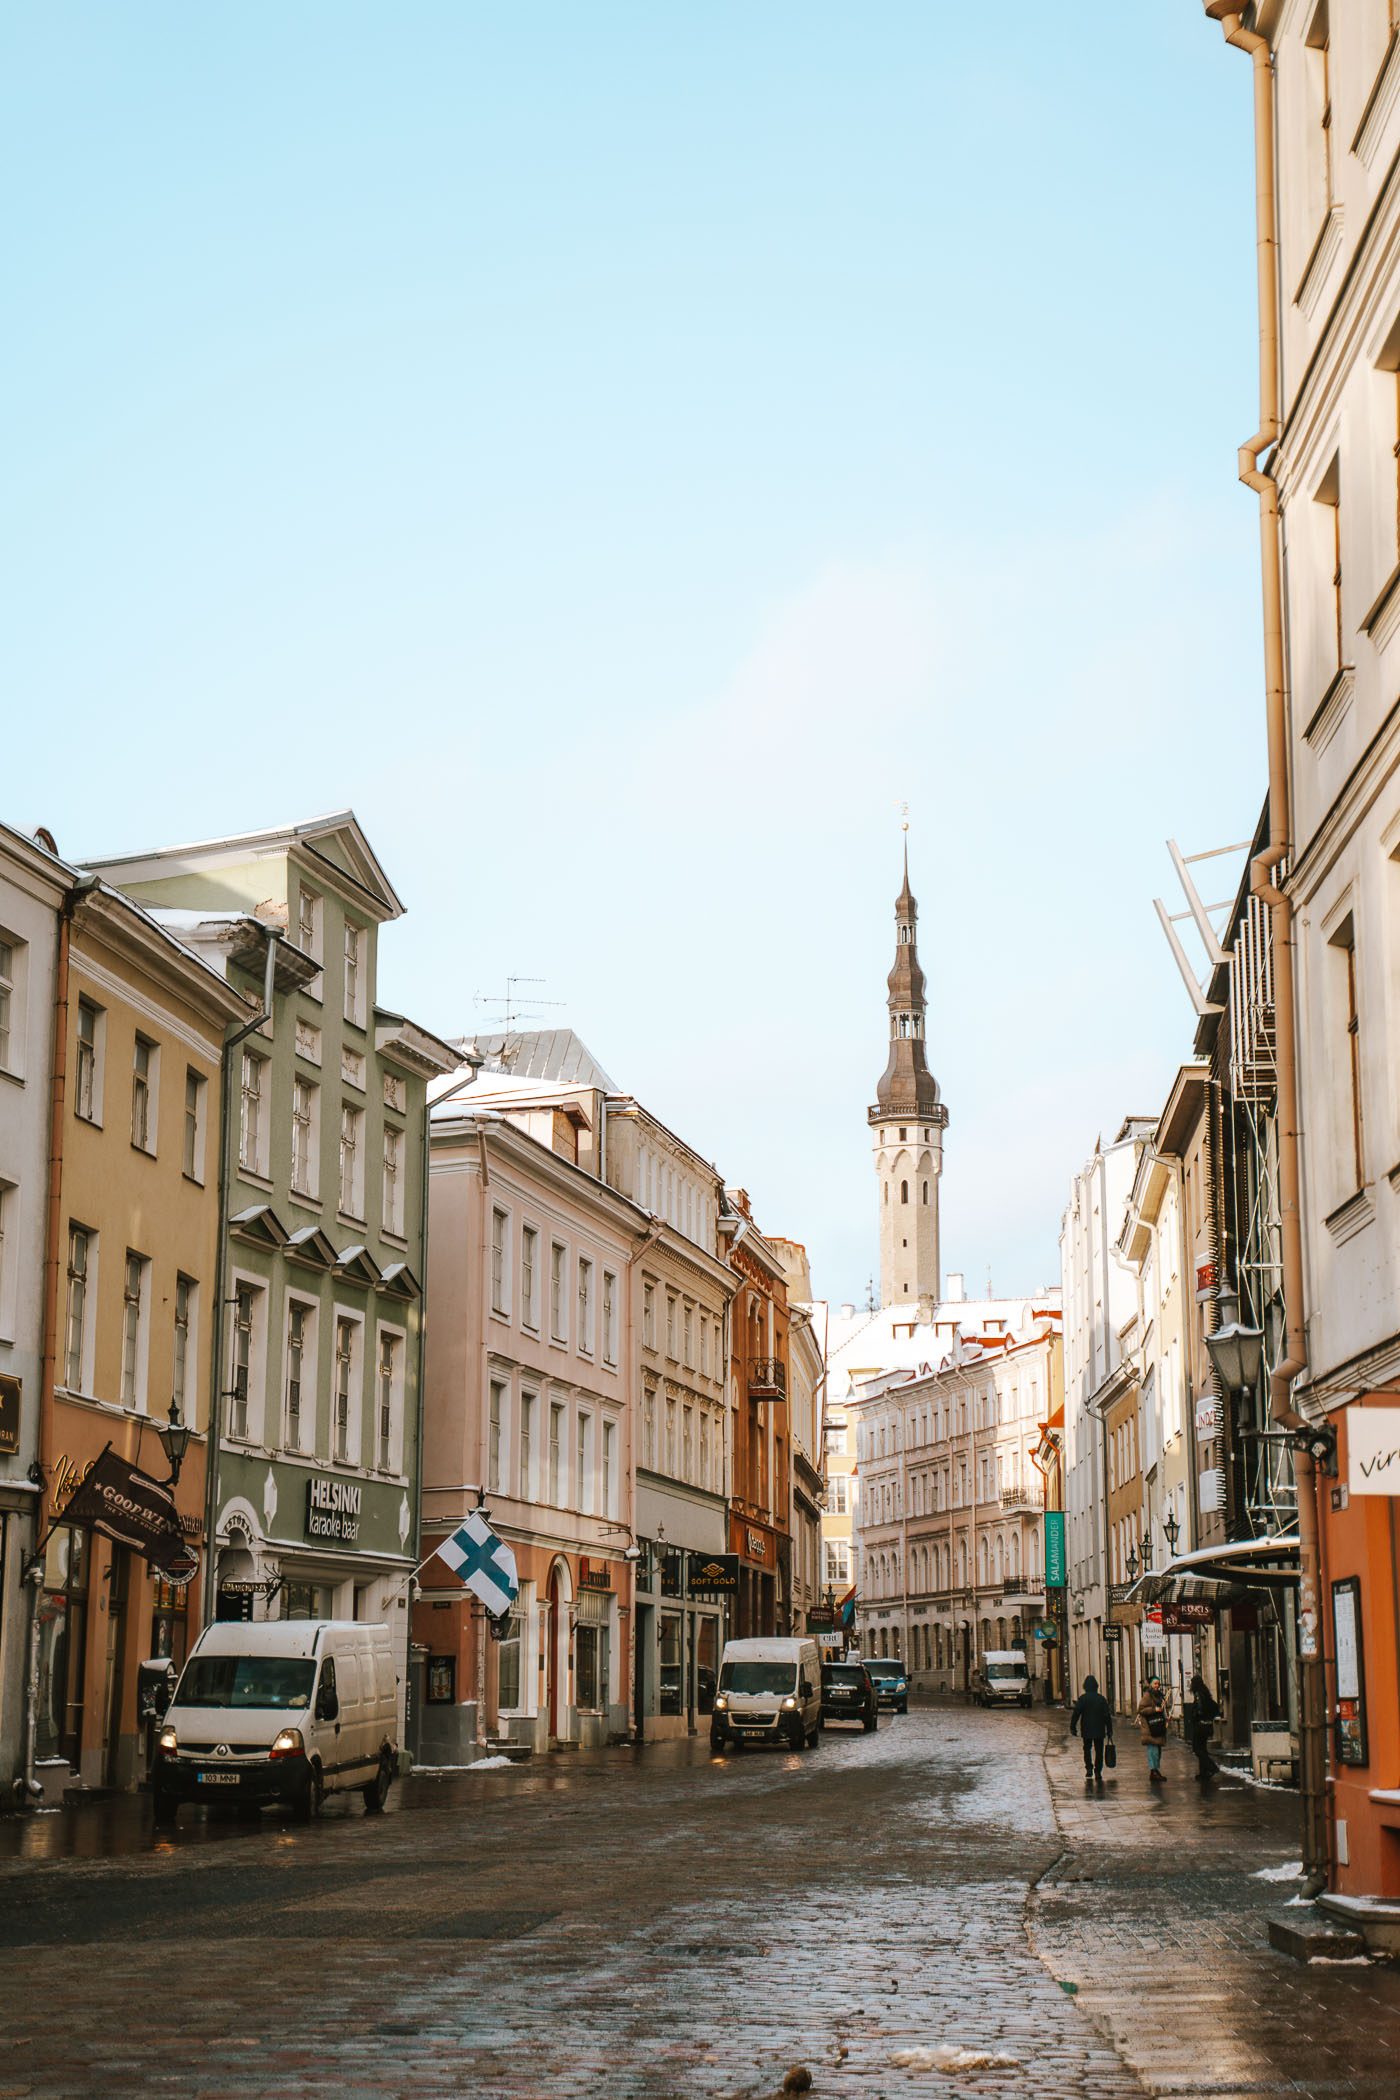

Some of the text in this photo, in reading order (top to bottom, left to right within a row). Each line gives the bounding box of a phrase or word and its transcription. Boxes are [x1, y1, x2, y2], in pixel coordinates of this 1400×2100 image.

[1360, 1450, 1400, 1478] Vir
[311, 1478, 361, 1515] HELSINKI
[309, 1507, 360, 1540] karaoke baar
[1050, 1519, 1060, 1582] SALAMANDER
[713, 1577, 736, 1585] GOLD
